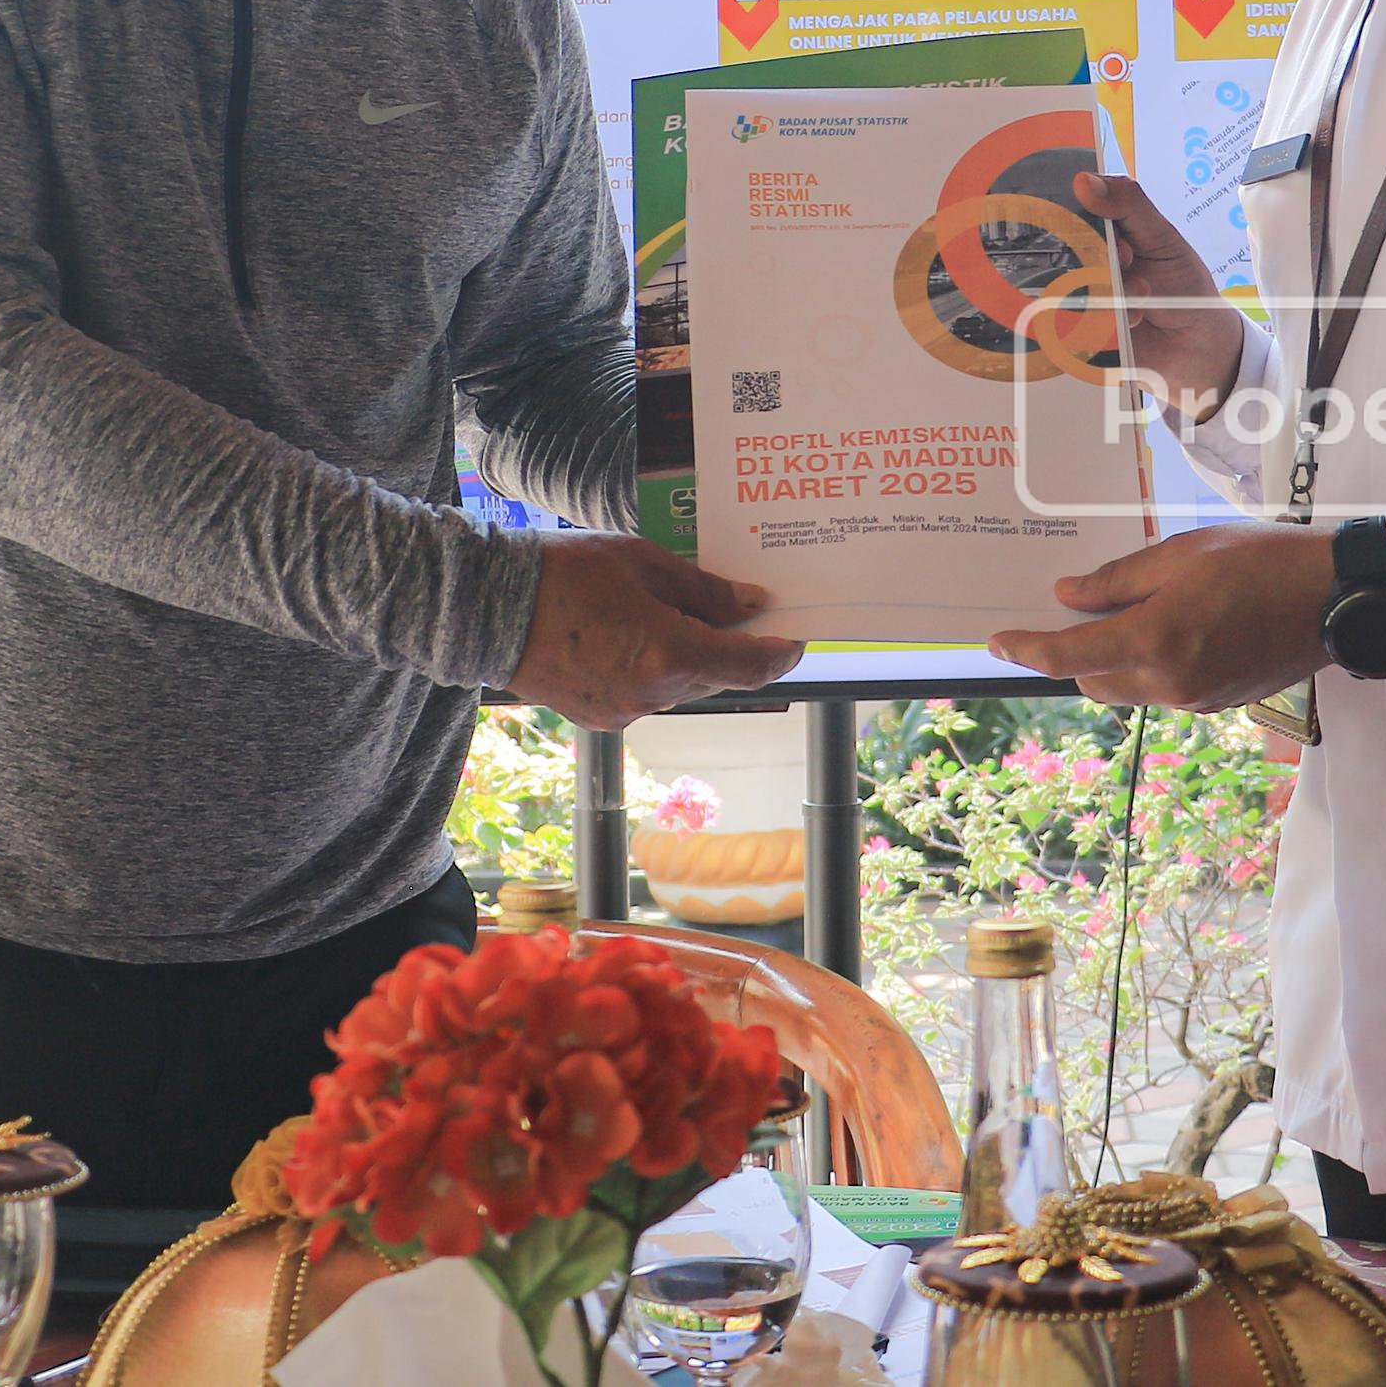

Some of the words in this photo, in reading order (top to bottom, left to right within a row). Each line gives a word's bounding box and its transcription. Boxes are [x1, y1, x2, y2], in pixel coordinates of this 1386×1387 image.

[788, 14, 889, 30] MENGAJAK
[893, 12, 940, 27] PARA
[945, 9, 1011, 25] PELAKU
[1016, 7, 1078, 23] USAHA
[789, 34, 853, 50] ONLINE
[778, 117, 817, 126] BADAN
[819, 117, 854, 126] PUSAT
[857, 117, 909, 126] STATISTIK
[779, 128, 808, 136] KOTA
[811, 128, 856, 136] MADIUN
[748, 172, 819, 186] BERITA
[749, 188, 810, 201] RESMI
[749, 203, 853, 217] STATISTIK
[735, 433, 833, 453] PROFIL
[840, 426, 1018, 447] KEMISKINAN
[736, 456, 773, 476] DI
[784, 451, 874, 473] KOTA
[883, 447, 1020, 468] MADIUN
[737, 475, 867, 503] MARET
[879, 472, 977, 495] 2025
[761, 519, 817, 530] Persentase
[830, 516, 879, 525] Penduduk
[893, 515, 925, 523] Miskin
[938, 515, 961, 523] Kota
[974, 516, 1010, 525] Madiun
[1023, 518, 1077, 529] mengalami
[761, 529, 813, 540] penurunan
[817, 525, 835, 535] dari
[839, 525, 859, 534] 4,38
[862, 524, 896, 534] persen
[899, 523, 918, 532] dari
[921, 524, 950, 532] Maret
[953, 524, 977, 533] 2024
[980, 525, 1019, 536] menjadi
[1045, 528, 1077, 537] persen
[761, 538, 786, 549] pada
[789, 536, 818, 546] Maret
[821, 534, 845, 544] 2025
